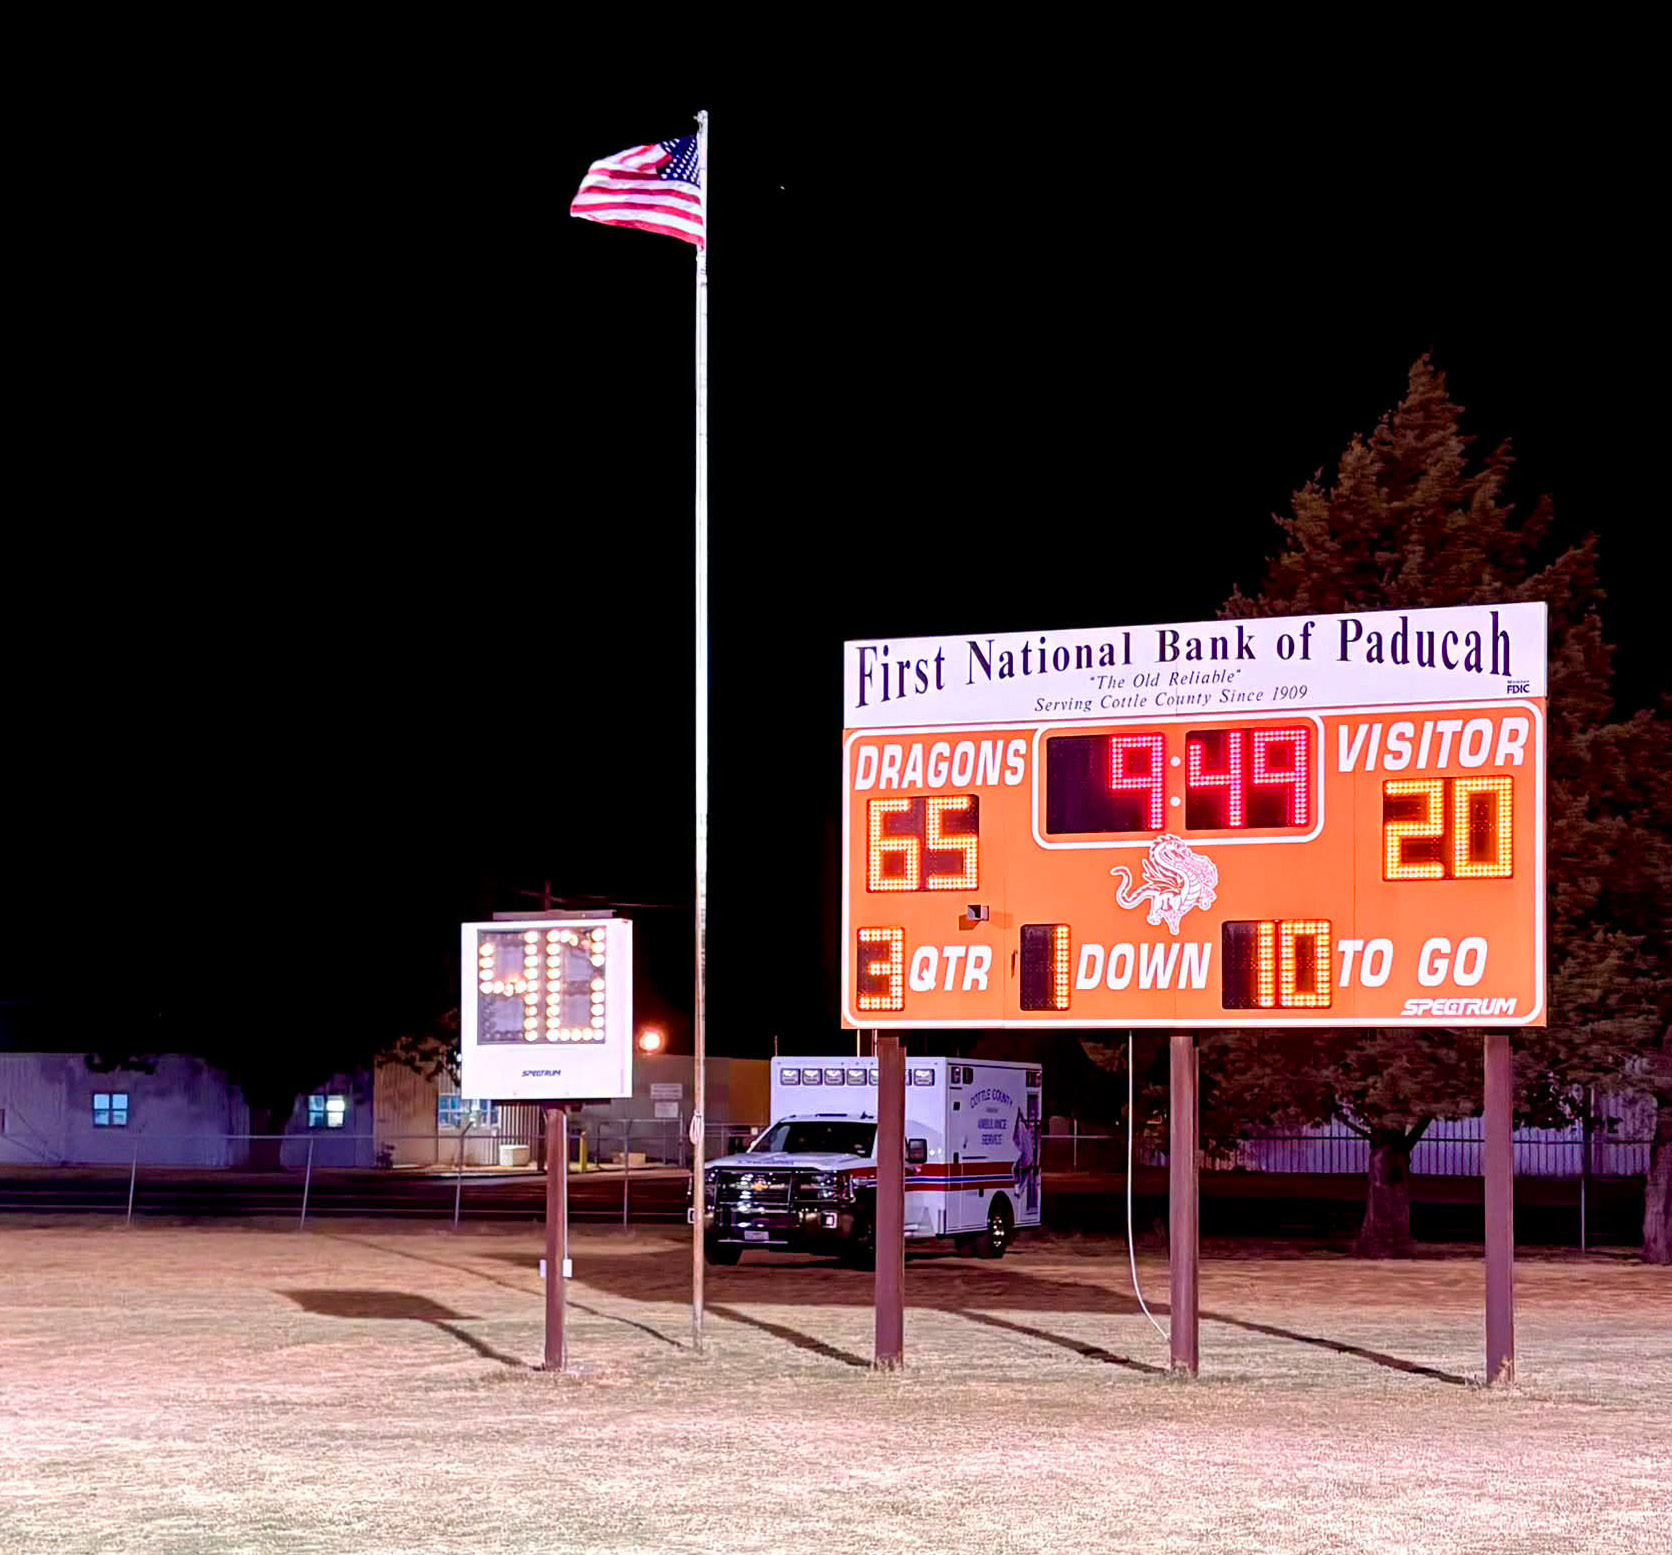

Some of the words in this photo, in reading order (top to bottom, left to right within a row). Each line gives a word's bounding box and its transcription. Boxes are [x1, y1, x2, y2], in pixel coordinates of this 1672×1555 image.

[855, 645, 945, 709] First
[965, 631, 1133, 686] National
[1155, 625, 1257, 663] Bank
[1276, 621, 1316, 661] of
[1336, 610, 1513, 677] Paducah
[1133, 672, 1161, 688] Old
[1034, 697, 1093, 713] Serving
[1100, 693, 1148, 709] Cottle
[1155, 691, 1212, 707] County
[1219, 688, 1265, 704] Since
[1272, 684, 1308, 701] 1909
[1506, 684, 1530, 694] FDIC
[854, 739, 1028, 791] DRAGONS
[1337, 716, 1530, 773] VISITOR
[868, 796, 979, 892] 65
[1385, 776, 1514, 880] 20
[858, 927, 904, 1011] 3
[908, 945, 993, 993] QTR
[1054, 923, 1071, 1010] 1
[1075, 942, 1213, 991] DOWN
[1257, 920, 1331, 1008] 10
[1337, 938, 1394, 988] TO
[1417, 936, 1489, 988] GO
[1400, 997, 1518, 1016] SPECTRUM
[521, 1069, 562, 1078] SPECTRUM
